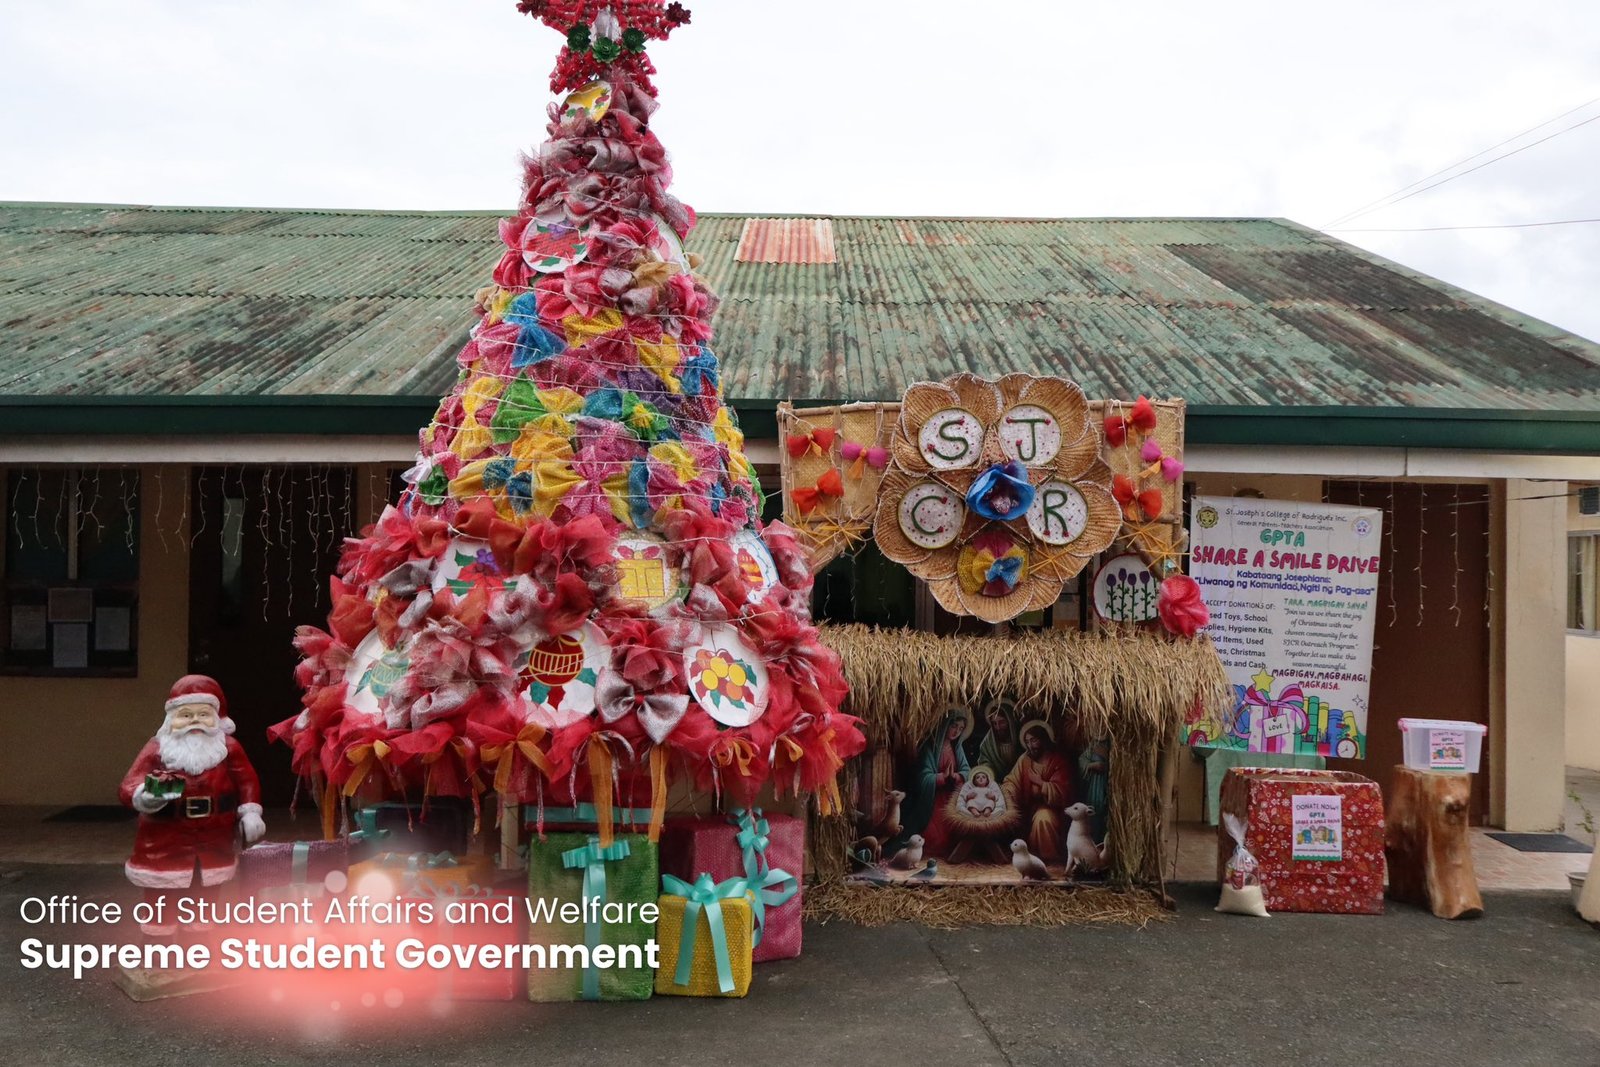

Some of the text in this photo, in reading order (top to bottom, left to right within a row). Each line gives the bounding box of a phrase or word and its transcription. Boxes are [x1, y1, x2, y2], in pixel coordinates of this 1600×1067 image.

[927, 417, 1051, 461] S J
[911, 489, 1070, 538] C R
[1266, 511, 1291, 521] College
[1292, 511, 1300, 519] of
[1260, 528, 1305, 547] GPTA
[1192, 545, 1380, 574] SHARE A SMILE DRIVE
[1237, 570, 1331, 584] Kabataang Josephians:
[1237, 581, 1247, 590] ng
[1322, 586, 1333, 594] ng
[1229, 601, 1264, 609] DONATIONS
[1244, 614, 1268, 622] School
[1229, 625, 1257, 634] Hygiene
[1258, 627, 1274, 635] Kits,
[1223, 636, 1245, 644] Items,
[1230, 648, 1266, 657] Christmas
[1268, 723, 1283, 731] LOVE
